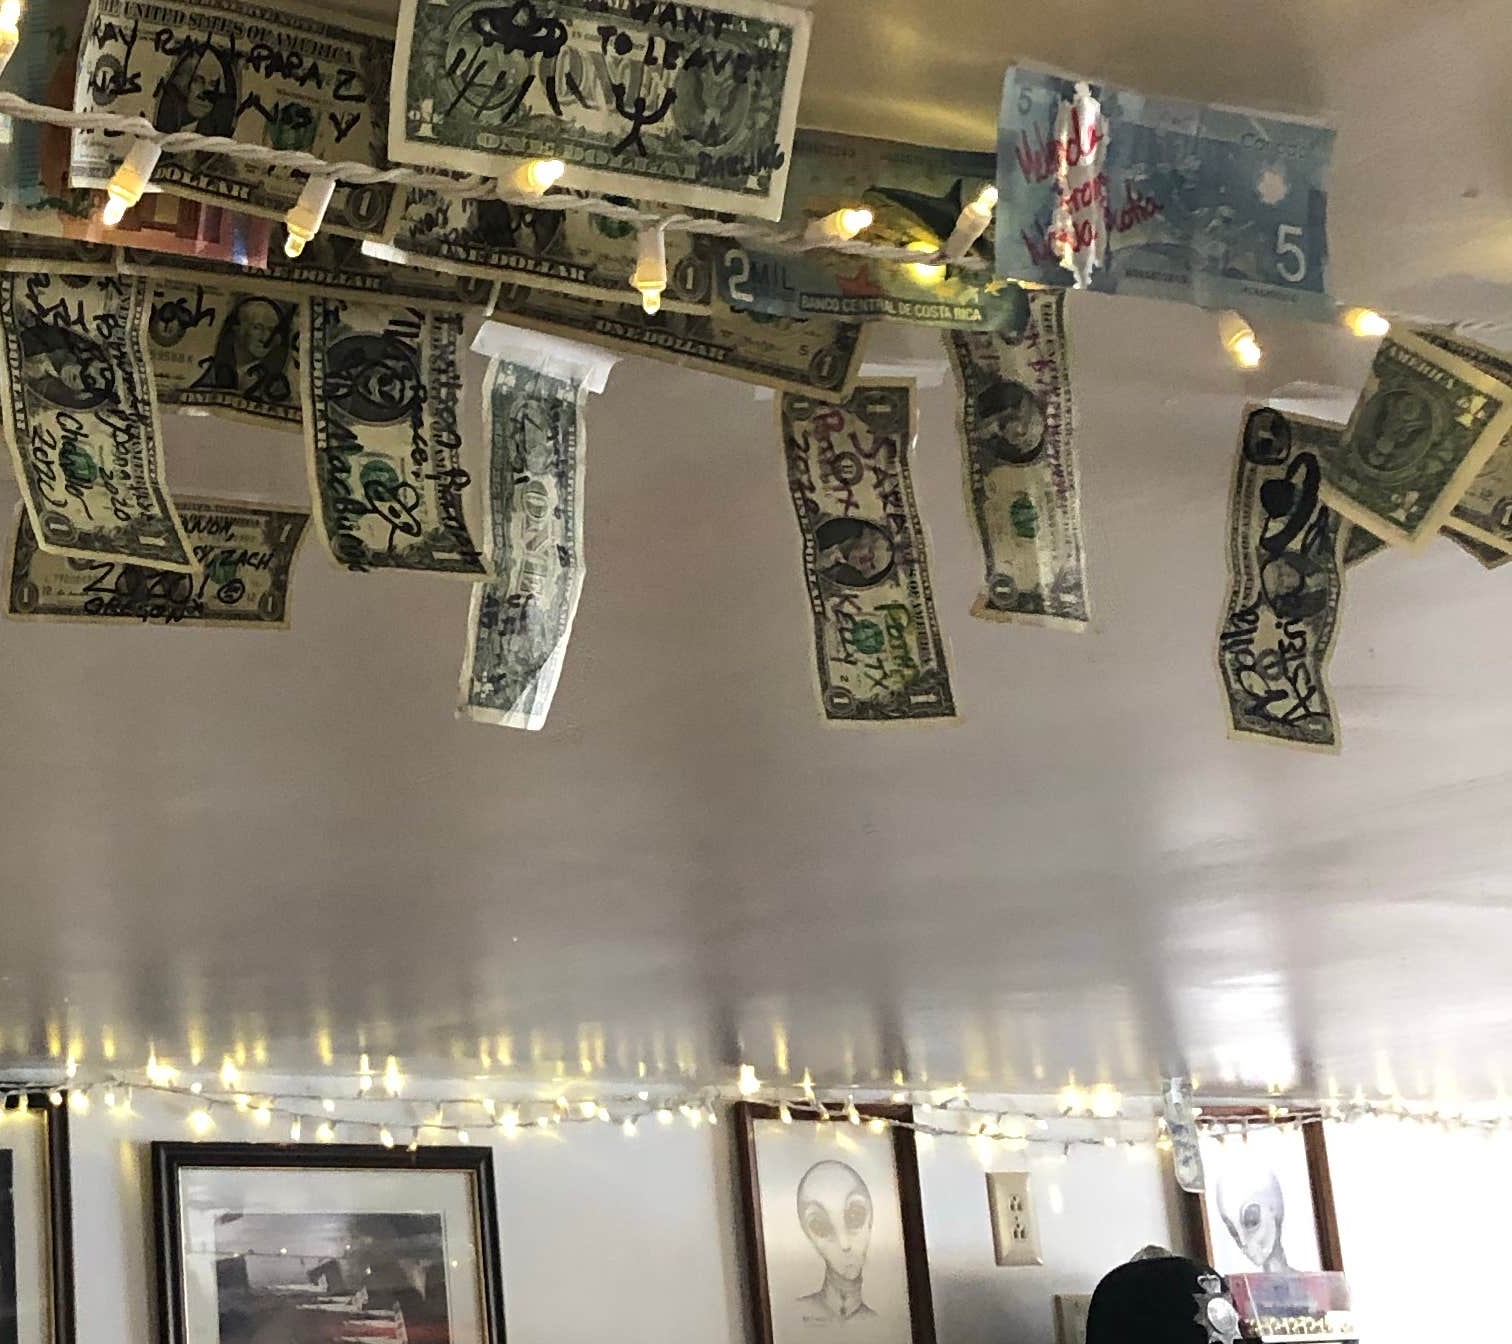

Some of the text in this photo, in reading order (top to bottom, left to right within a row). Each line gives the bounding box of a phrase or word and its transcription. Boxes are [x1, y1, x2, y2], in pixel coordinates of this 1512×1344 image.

[596, 24, 634, 57] TO
[1017, 87, 1033, 113] 5
[1275, 224, 1307, 283] 5
[727, 249, 752, 302] 2
[801, 294, 839, 313] BANCO
[898, 302, 913, 317] DE
[915, 303, 950, 319] COSTA
[952, 305, 984, 321] RICA
